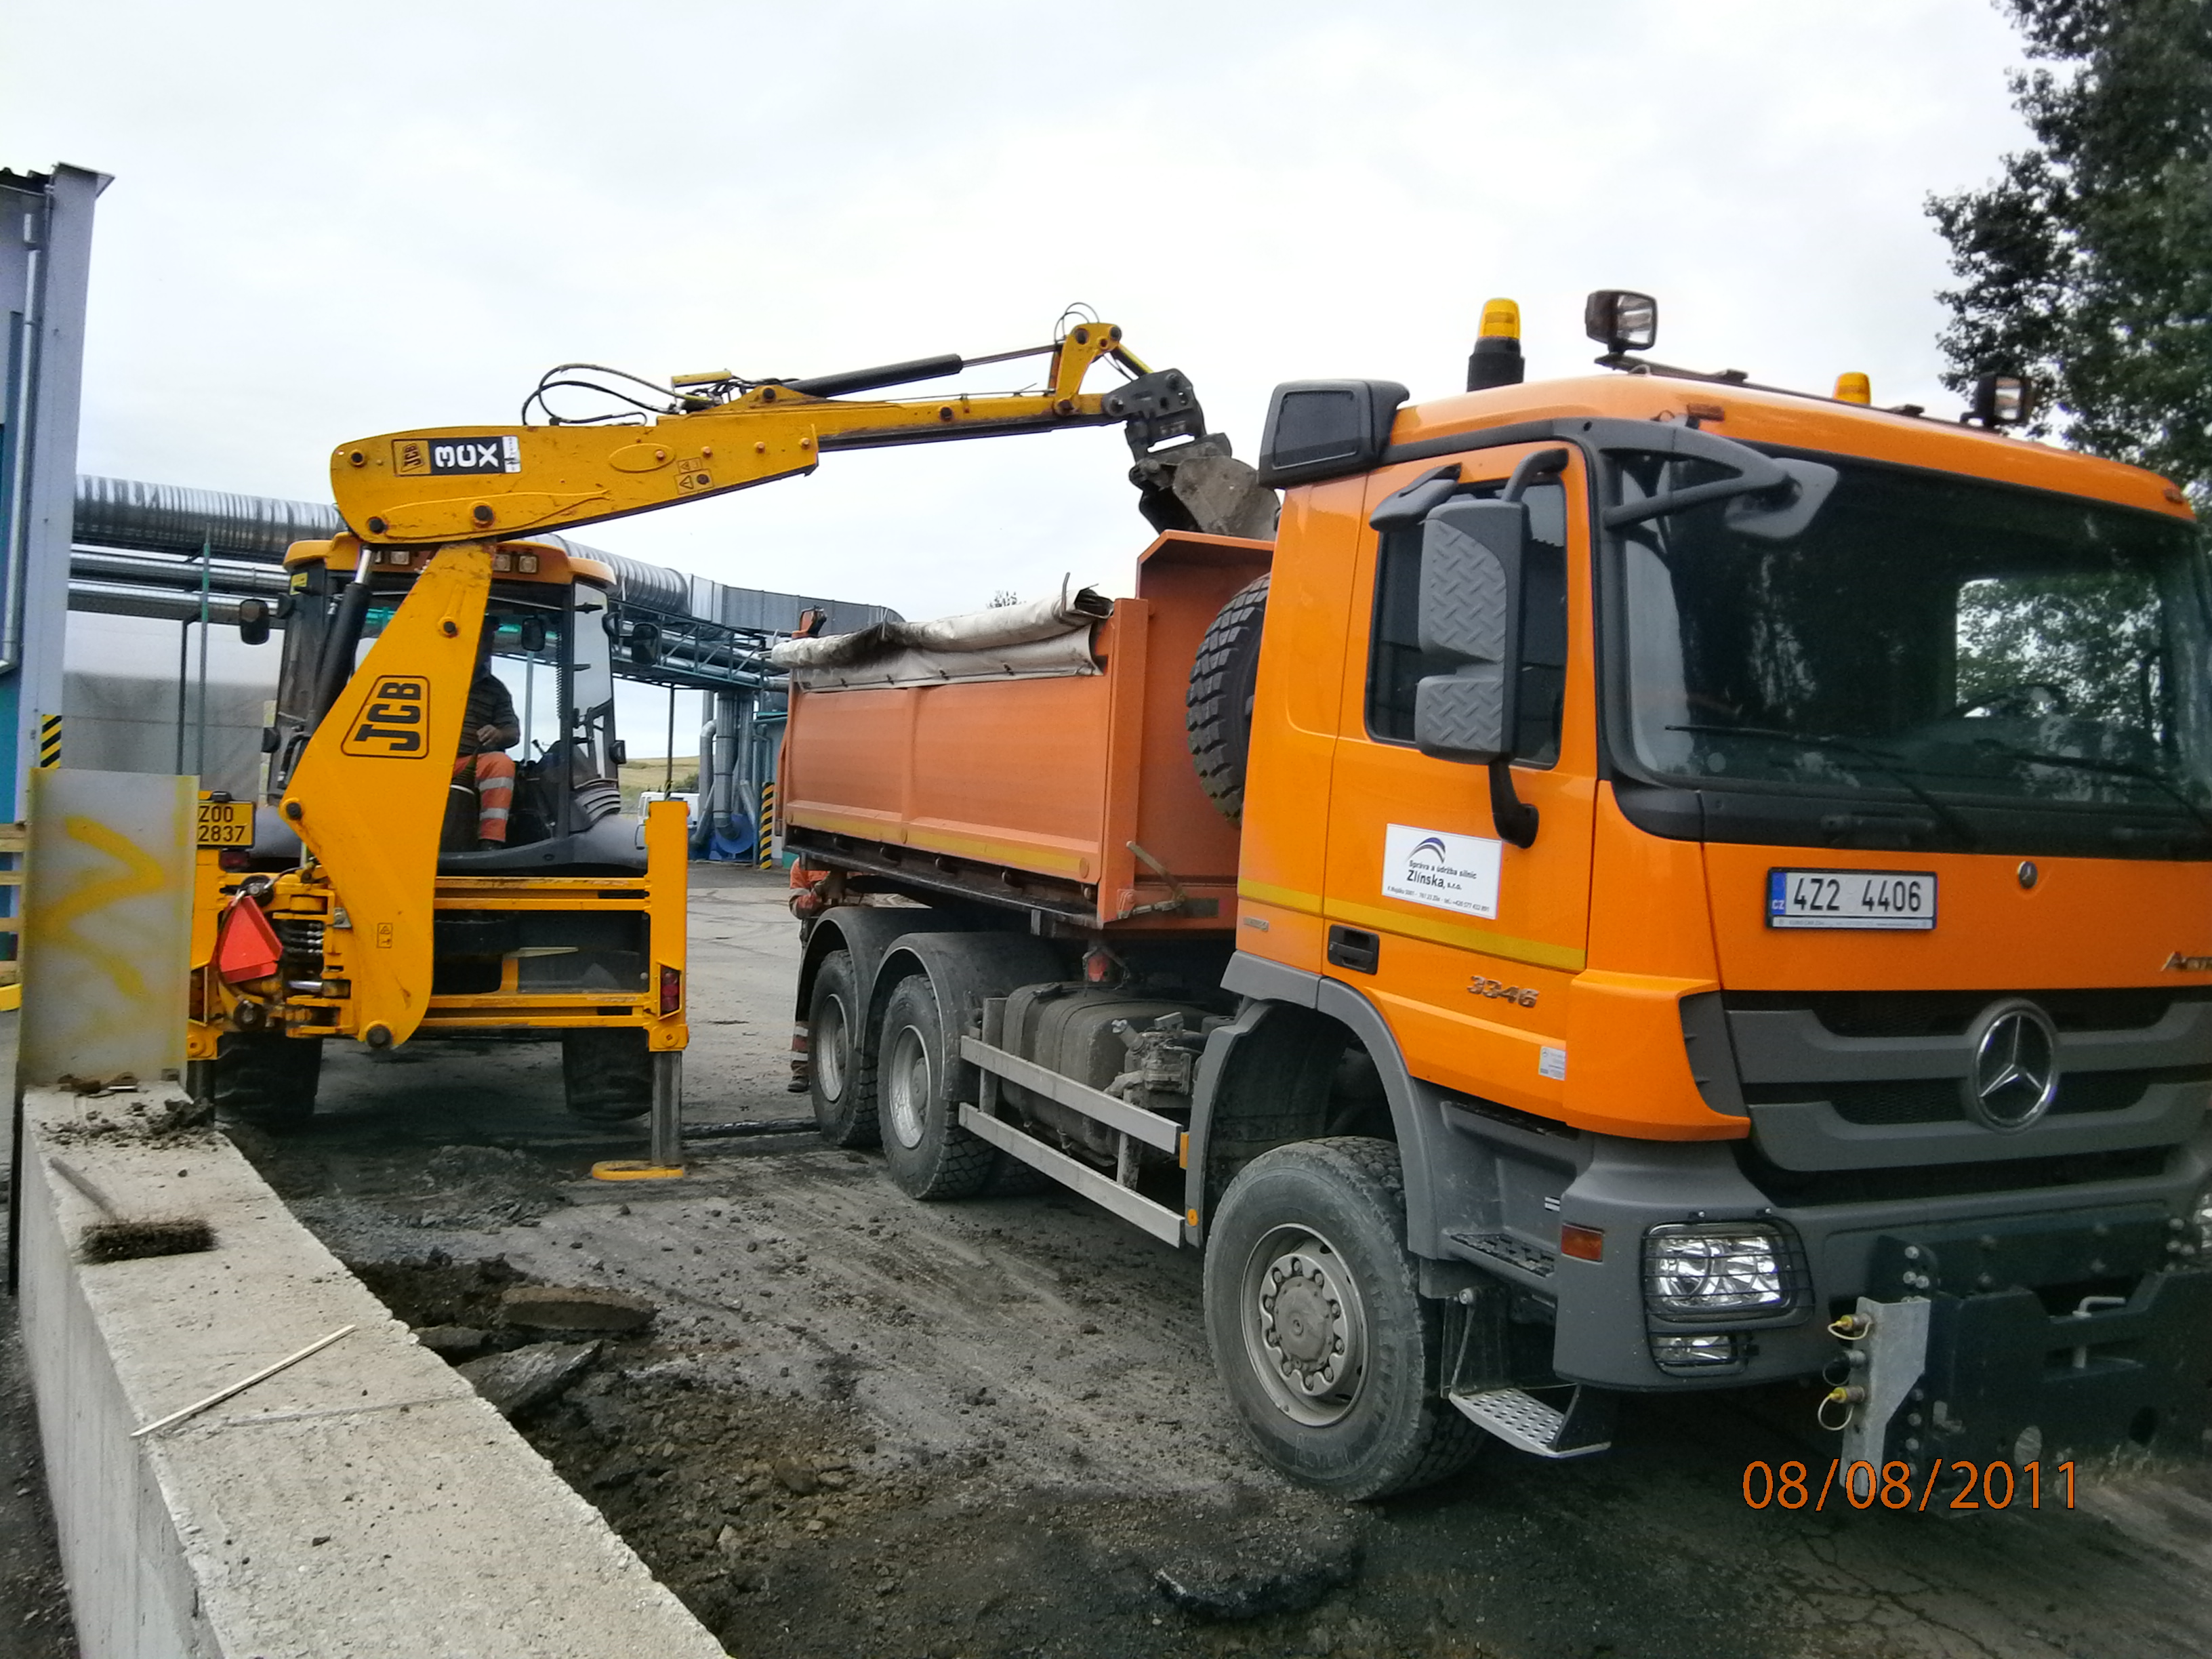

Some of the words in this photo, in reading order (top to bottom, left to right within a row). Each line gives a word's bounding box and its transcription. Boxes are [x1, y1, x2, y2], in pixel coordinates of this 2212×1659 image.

[353, 682, 421, 751] JCB
[198, 825, 247, 842] 2837
[1771, 899, 1785, 910] CZ
[1793, 878, 1841, 912] 4Z2
[1862, 880, 1921, 912] 4406
[1467, 975, 1540, 1008] 3346
